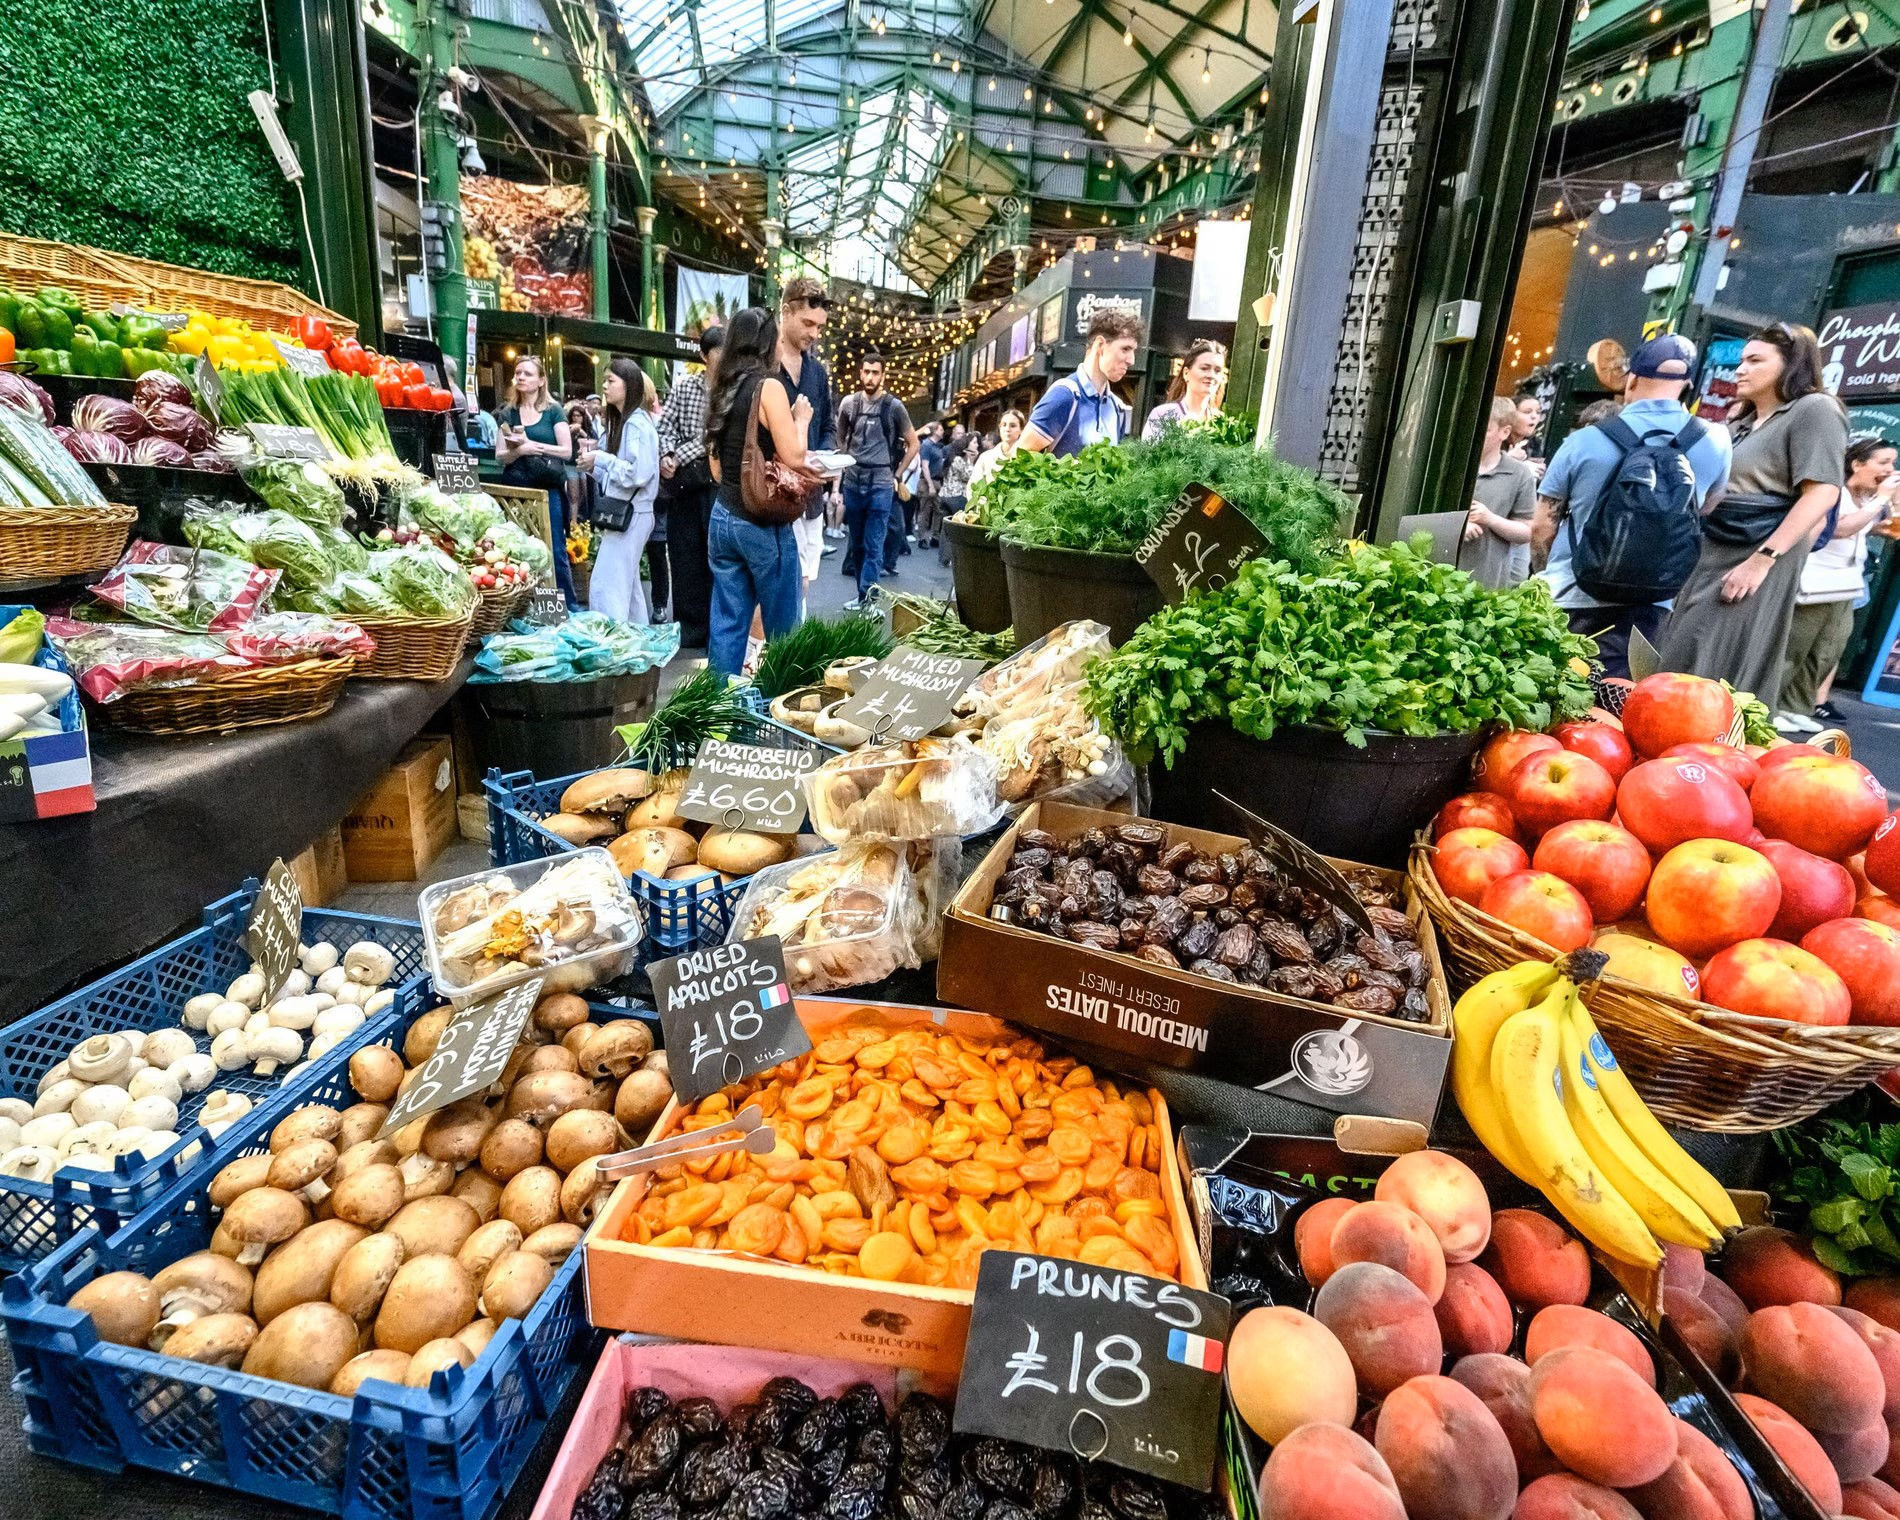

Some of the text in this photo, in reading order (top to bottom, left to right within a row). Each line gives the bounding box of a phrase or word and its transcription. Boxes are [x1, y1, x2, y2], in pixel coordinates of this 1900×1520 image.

[1846, 372, 1876, 387] sold
[1136, 492, 1202, 565] CORIANDER
[877, 664, 964, 701] MUSHROOM
[902, 652, 962, 676] MIXED
[697, 758, 801, 790] MUSHROOM
[279, 872, 300, 906] CUP
[667, 959, 778, 1012] APRICOTS
[677, 943, 747, 981] DRIED
[1046, 984, 1209, 1052] MEDJOUL DATES
[1078, 971, 1181, 1015] DESERT FINEST
[451, 986, 520, 1094] MUSHROOM
[482, 977, 544, 1072] CHESTNUT
[689, 1000, 763, 1075] £18
[1010, 1256, 1202, 1328] PRUNES
[1001, 1320, 1151, 1407] £18
